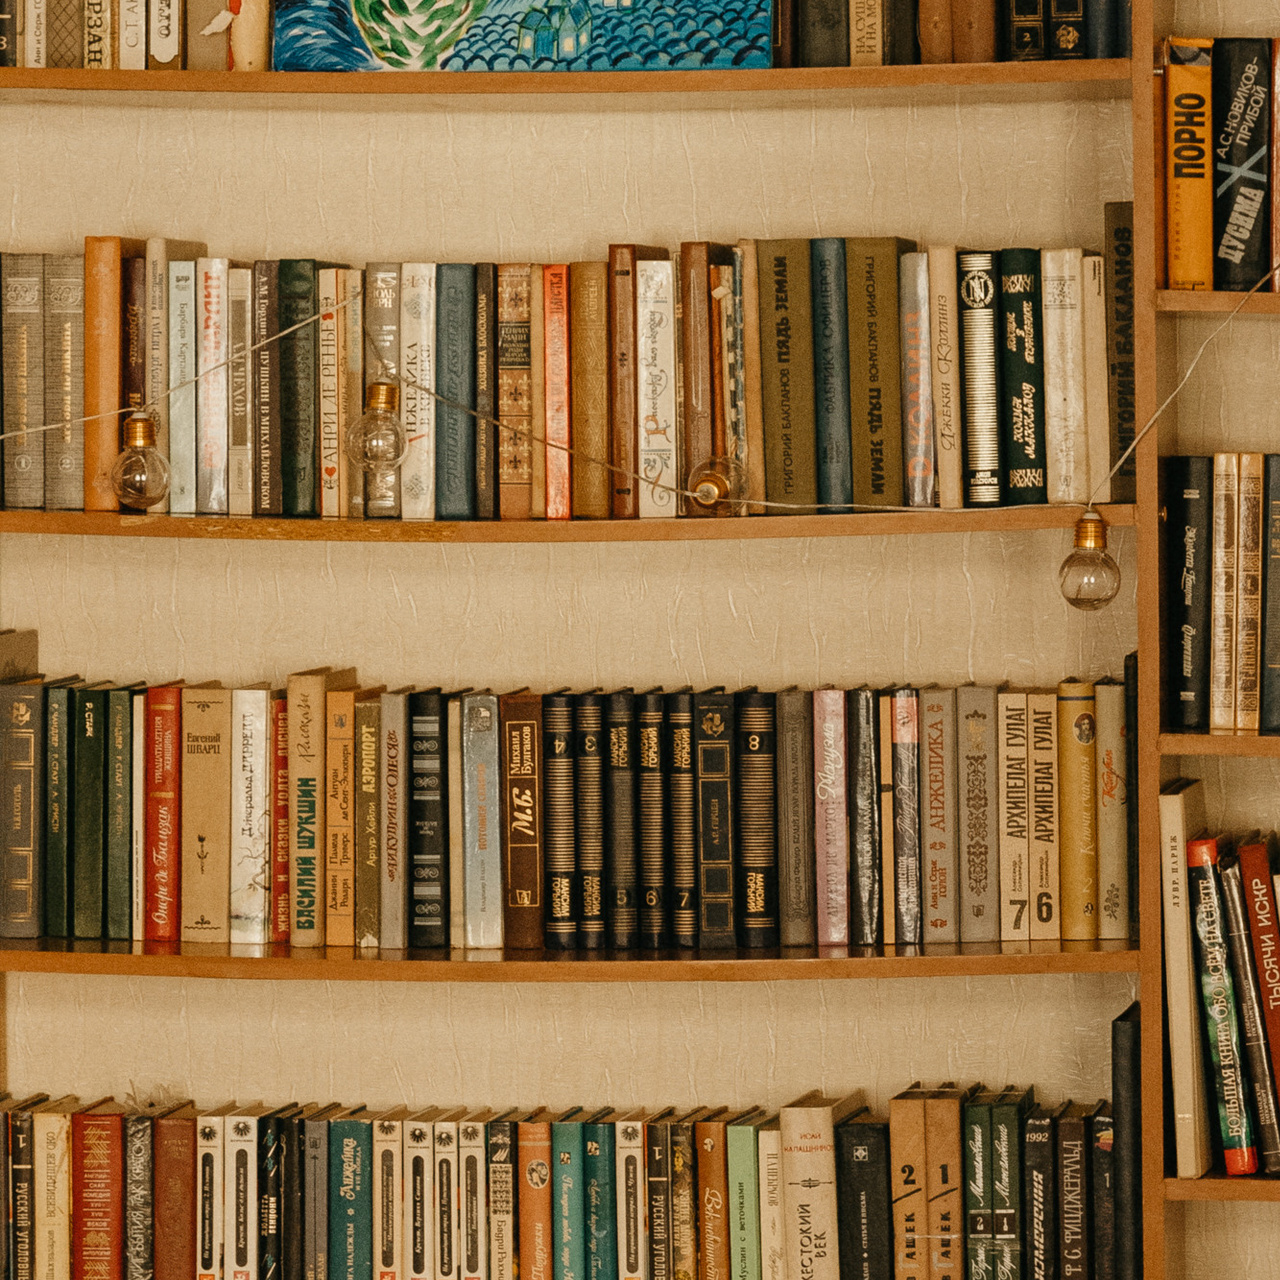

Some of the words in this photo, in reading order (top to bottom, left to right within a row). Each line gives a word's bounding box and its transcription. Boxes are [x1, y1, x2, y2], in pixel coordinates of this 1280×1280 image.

[855, 35, 866, 55] НА
[866, 22, 876, 38] НА
[866, 44, 876, 53] И
[1175, 92, 1205, 179] ПОРНО
[1236, 84, 1268, 146] ПРИБОЙ
[1218, 187, 1264, 264] ЦУСИМА
[775, 255, 788, 310] ЗЕМЛИ
[323, 323, 337, 377] РЕНЬЕ
[778, 317, 789, 363] ПЯДЬ
[260, 351, 271, 400] ПУШКИН
[323, 384, 337, 406] ДЕ
[781, 369, 791, 429] БАКЛАНОВ
[260, 416, 271, 509] МИХАЙЛОВСКОМ
[323, 412, 338, 464] АНРИ
[782, 434, 793, 494] ГРИГОРИЙ
[187, 744, 220, 755] ШВАРЦ
[522, 725, 531, 774] Булгаков
[1006, 706, 1026, 747] ГУЛАГ
[364, 725, 375, 793] АЭРОПОРТ
[511, 731, 520, 774] Михаил
[929, 719, 944, 832] АНЖЕЛИКА
[298, 777, 315, 850] ШУКШИН
[512, 789, 534, 836] М.Б.
[1006, 756, 1026, 839] АРХИПЕЛАГ
[298, 855, 314, 929] ВАСИЛИЙ
[1010, 899, 1027, 929] 7
[1036, 892, 1052, 922] 6
[1251, 878, 1272, 926] ИСКР
[1026, 1131, 1049, 1142] 1992
[901, 1165, 915, 1185] 2
[1065, 1140, 1082, 1243] ФИЦДЖЕРАЛЬД
[17, 1183, 29, 1225] РУССКИЙ
[815, 1231, 826, 1259] ВЕК
